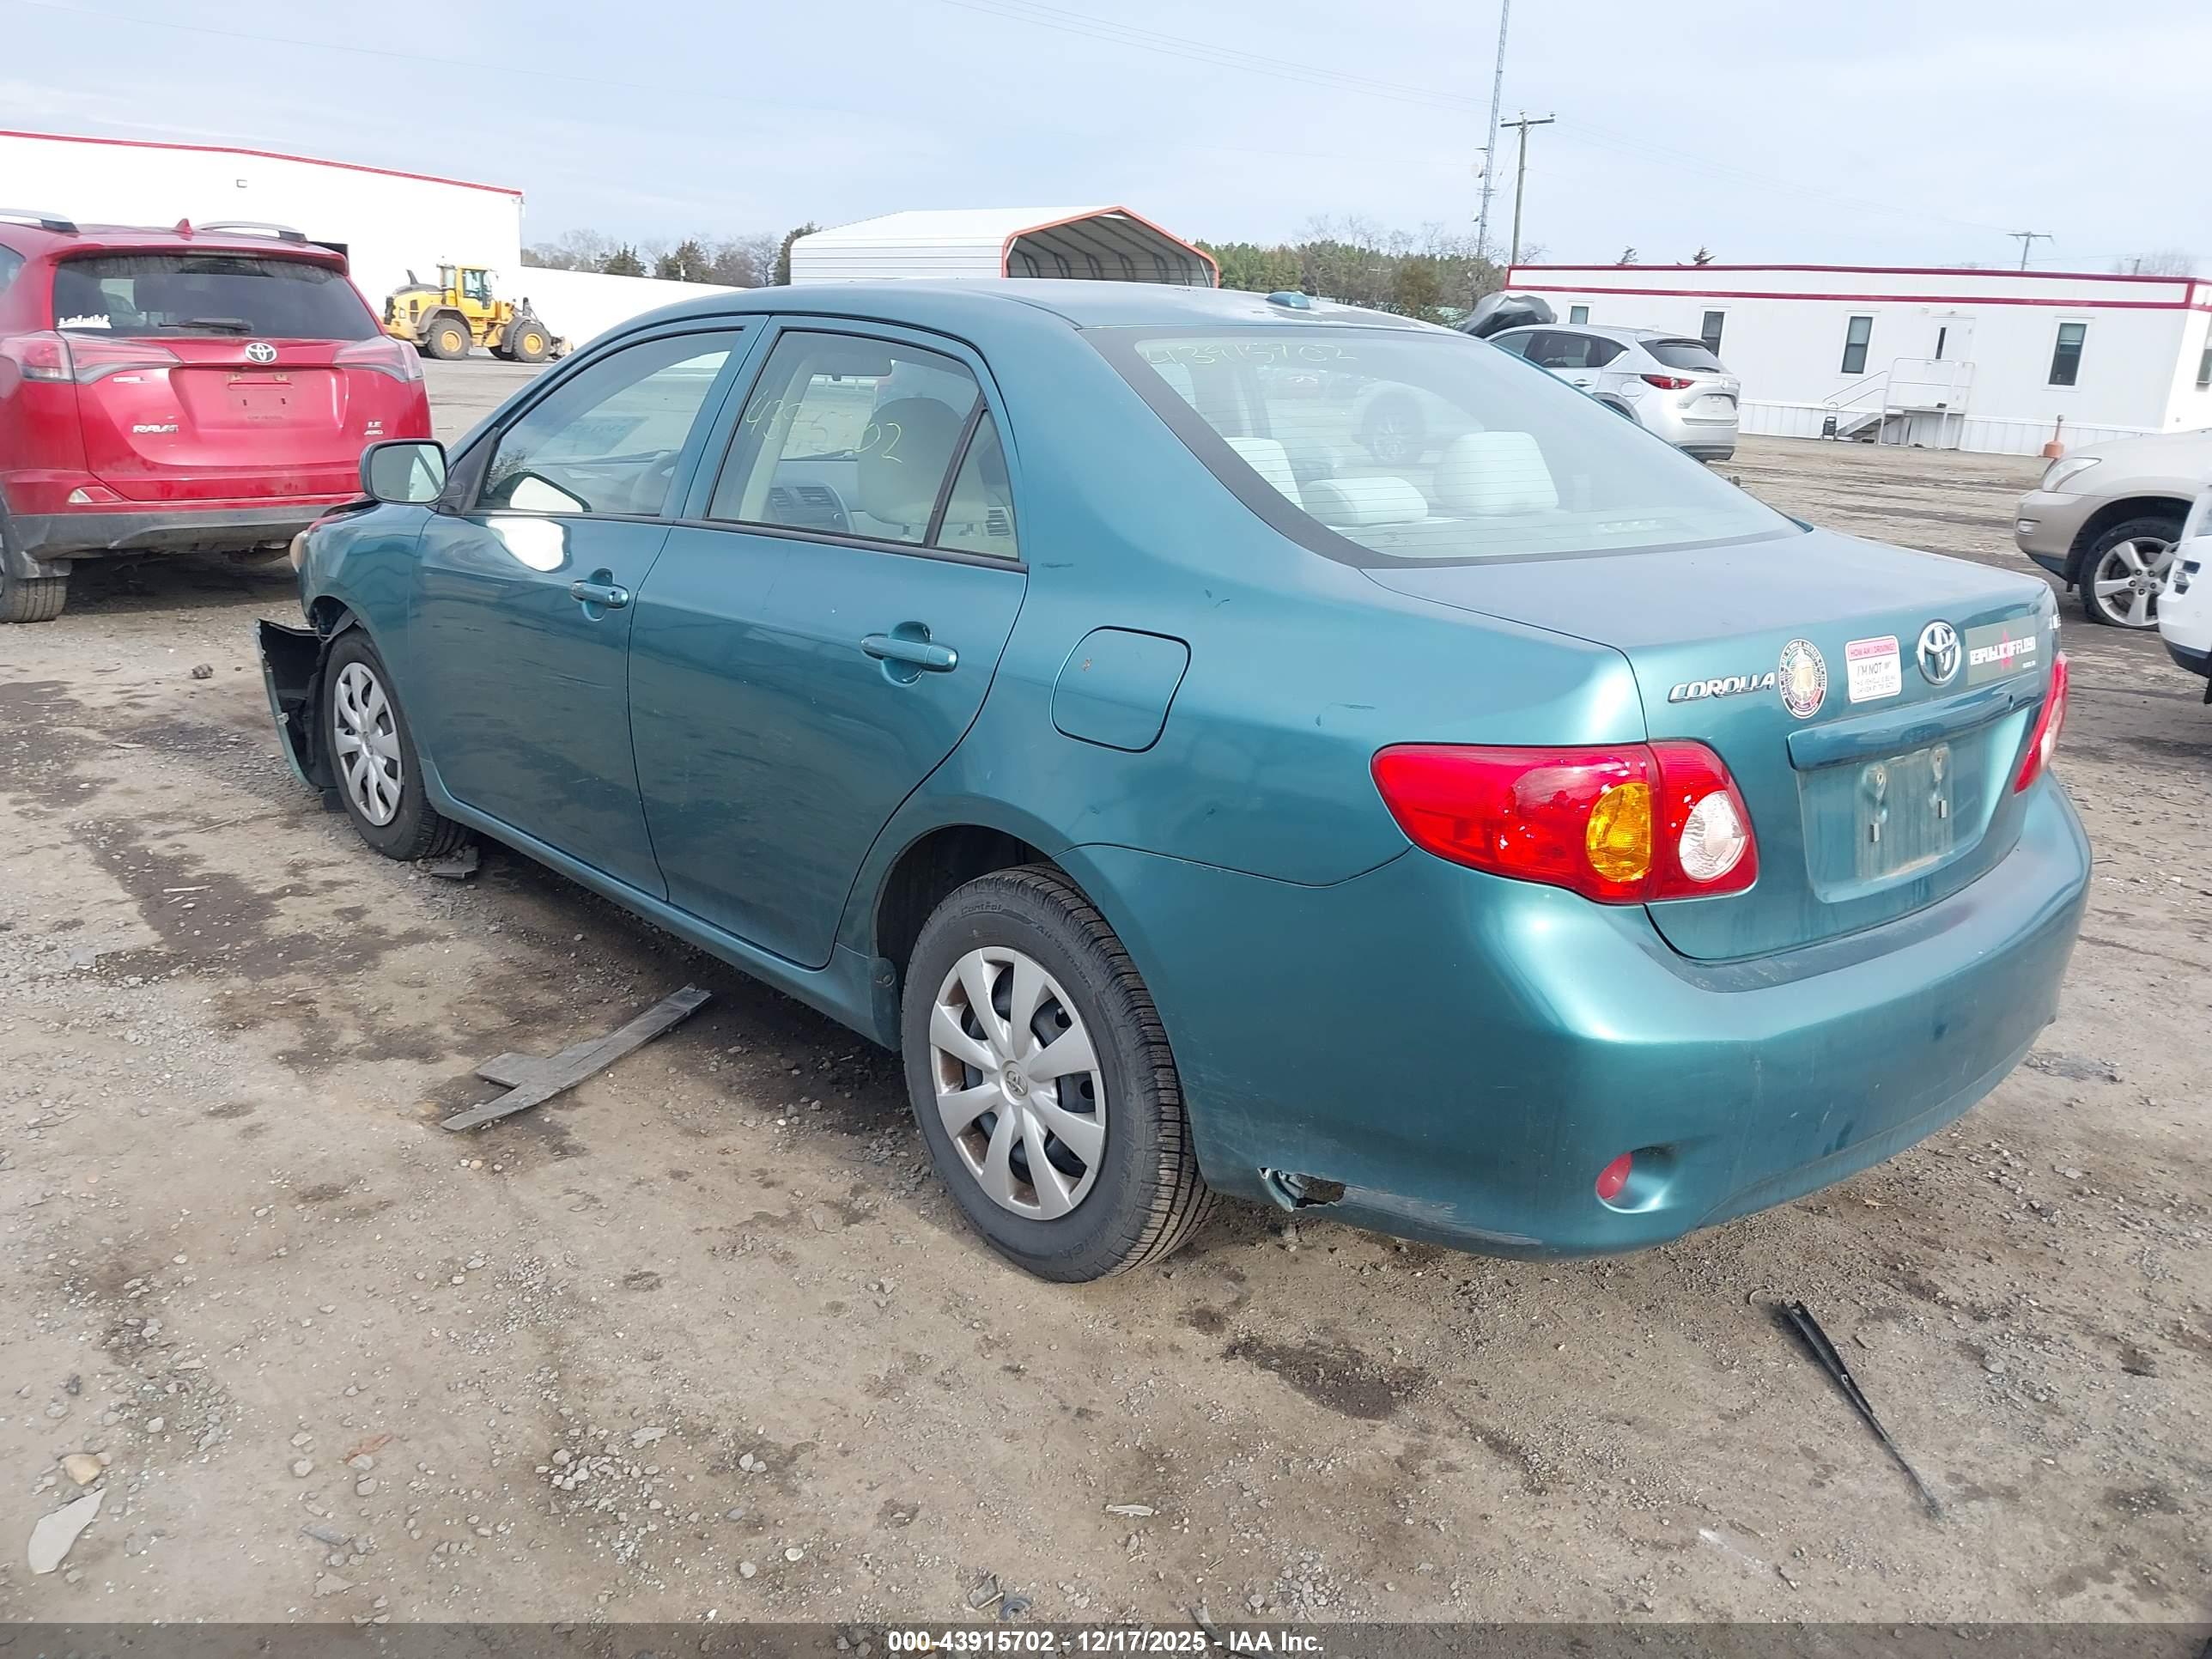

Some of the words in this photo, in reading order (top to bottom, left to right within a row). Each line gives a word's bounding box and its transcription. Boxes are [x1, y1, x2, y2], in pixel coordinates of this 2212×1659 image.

[132, 424, 179, 434] RAV4
[1668, 672, 1776, 702] COROLLA
[962, 902, 1003, 915] Control
